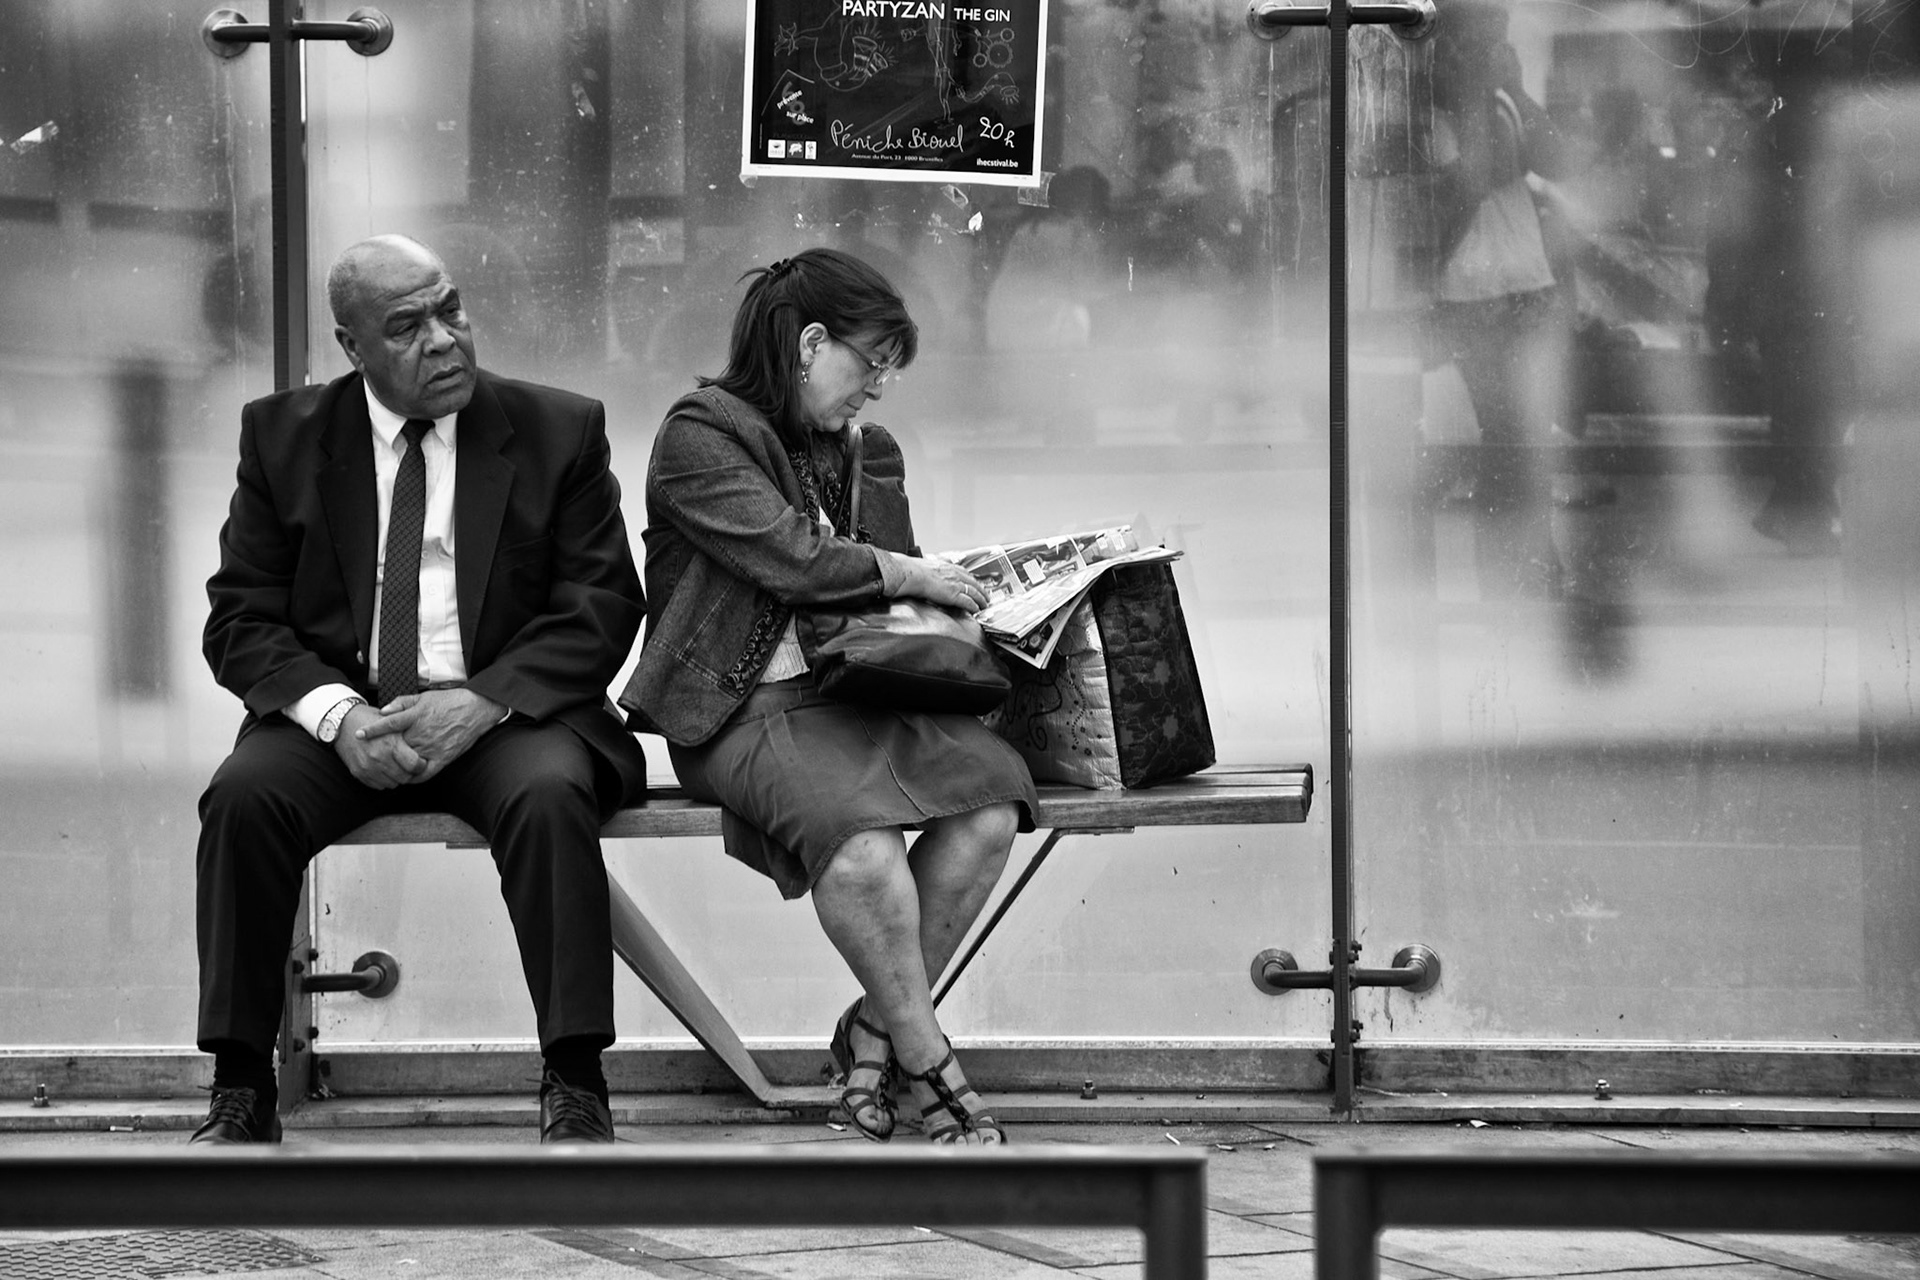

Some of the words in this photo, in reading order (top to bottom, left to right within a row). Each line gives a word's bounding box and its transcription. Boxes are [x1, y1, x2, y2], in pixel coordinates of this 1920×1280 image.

[842, 0, 945, 19] PARTYZAN
[954, 7, 980, 21] THE
[984, 8, 1011, 22] GIN
[797, 113, 814, 124] place
[830, 119, 904, 153] Péniche
[976, 157, 1019, 169] ihecstival.be
